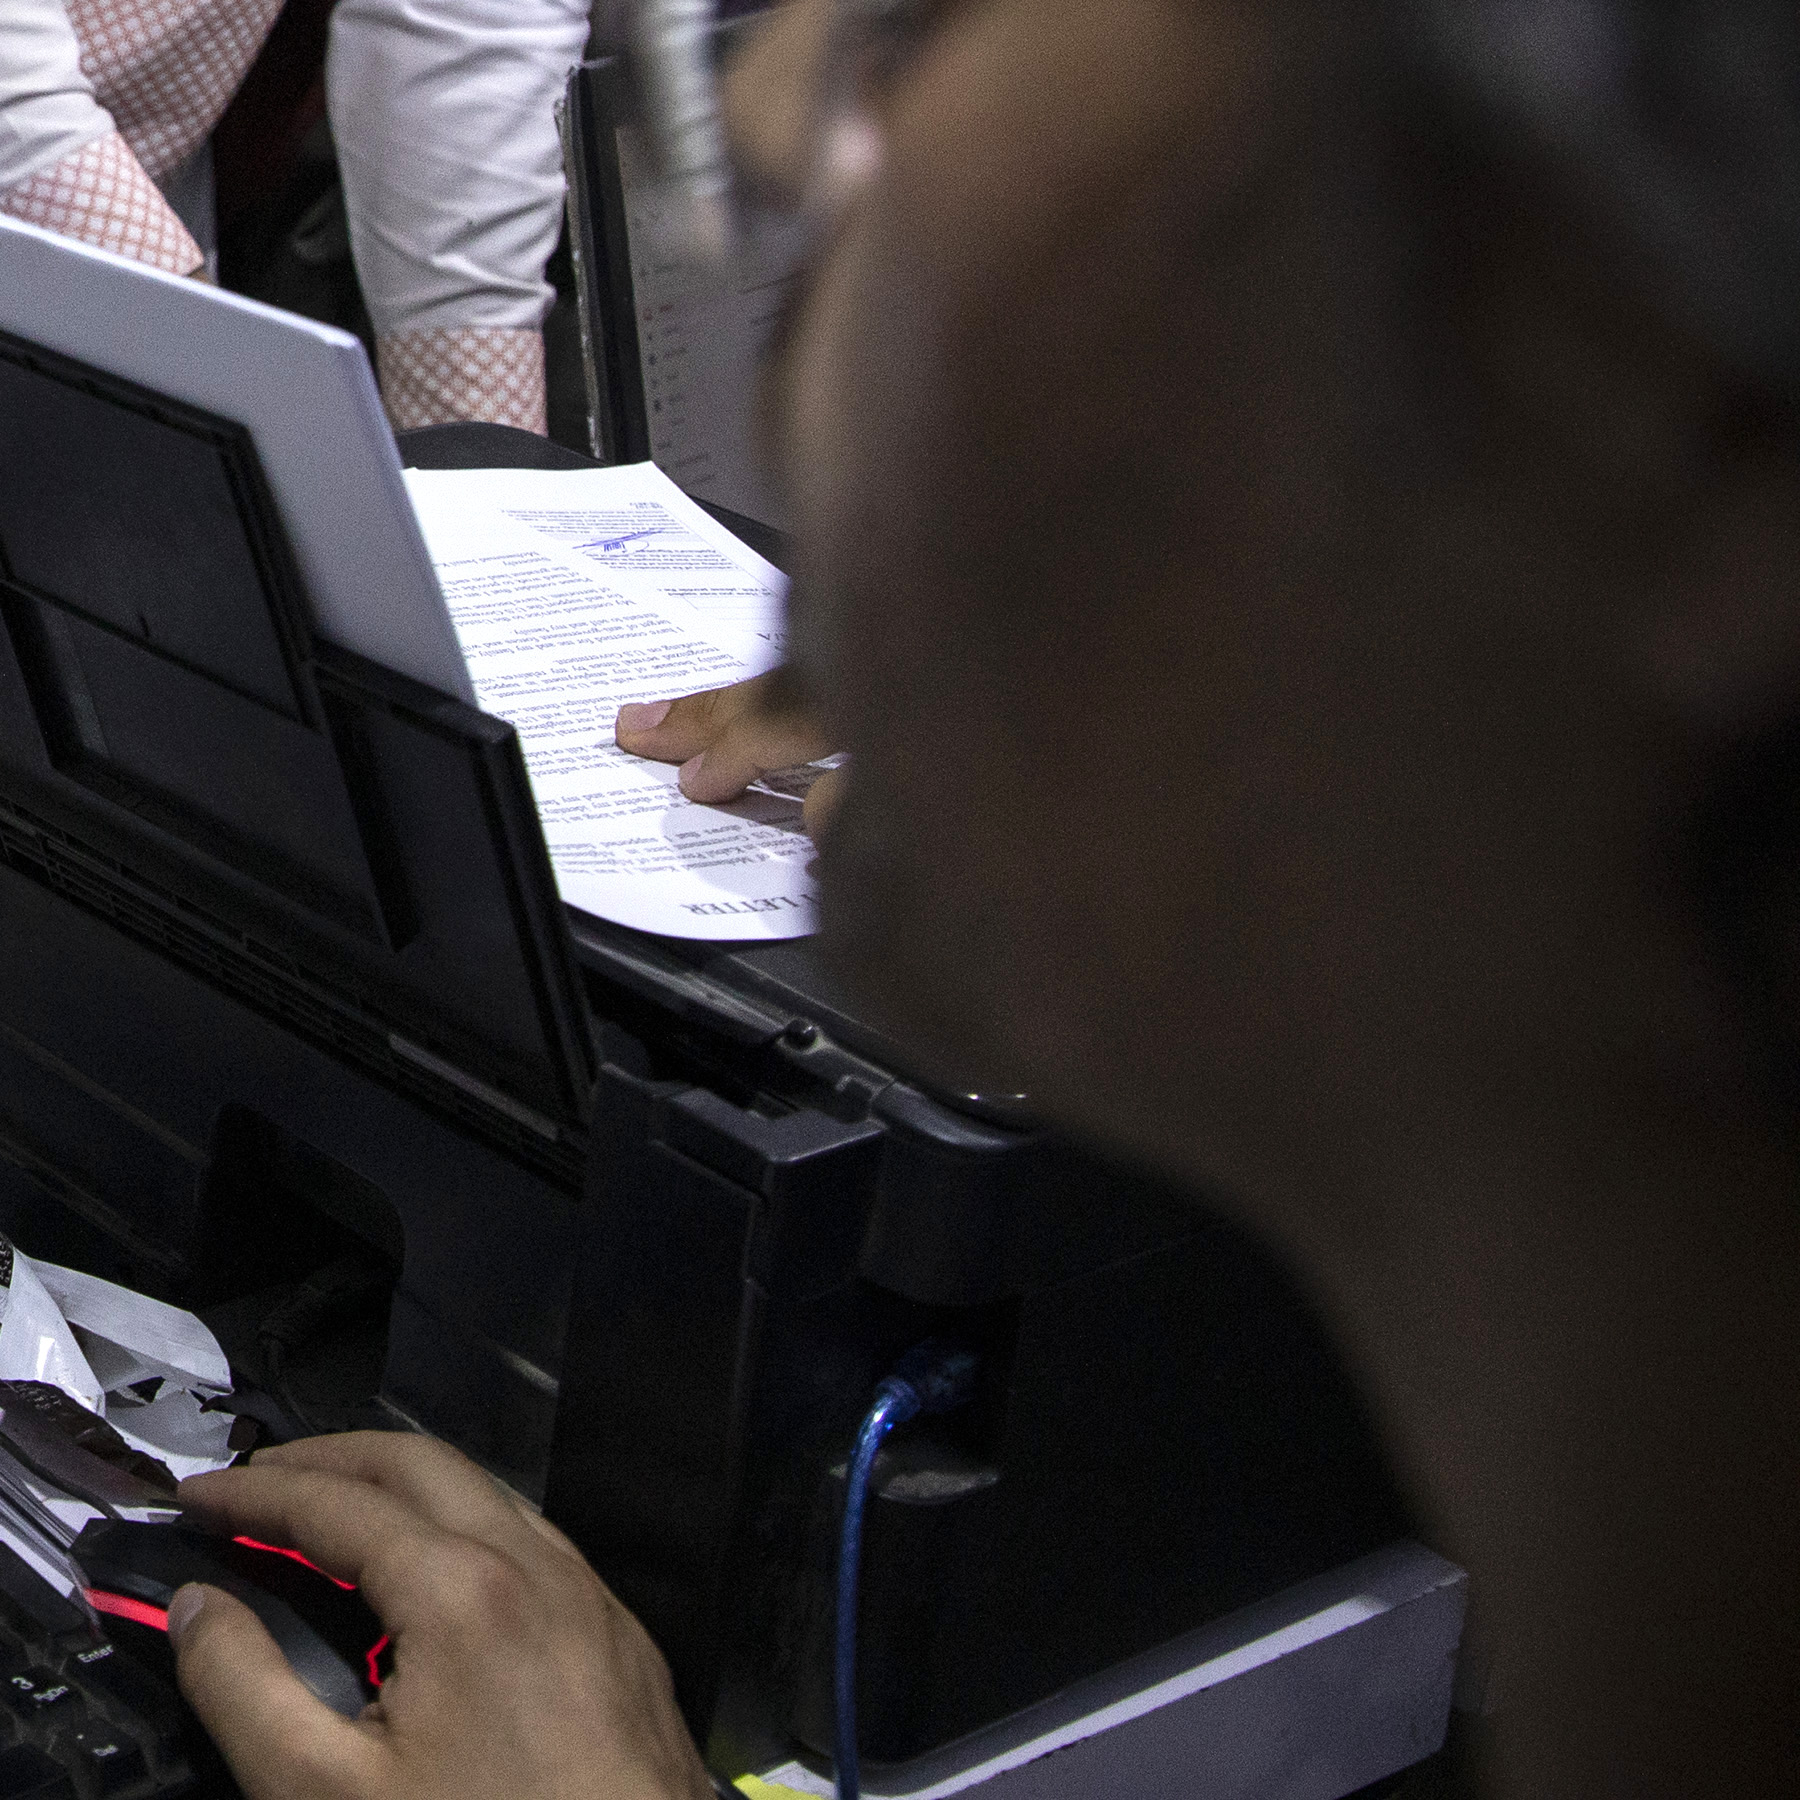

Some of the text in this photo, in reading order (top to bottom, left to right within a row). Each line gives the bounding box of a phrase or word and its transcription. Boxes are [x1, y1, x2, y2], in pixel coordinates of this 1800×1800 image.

[680, 897, 800, 915] LETTER
[77, 1644, 115, 1664] Enter
[12, 1676, 70, 1702] 3 PgDn
[92, 1744, 119, 1758] Del
